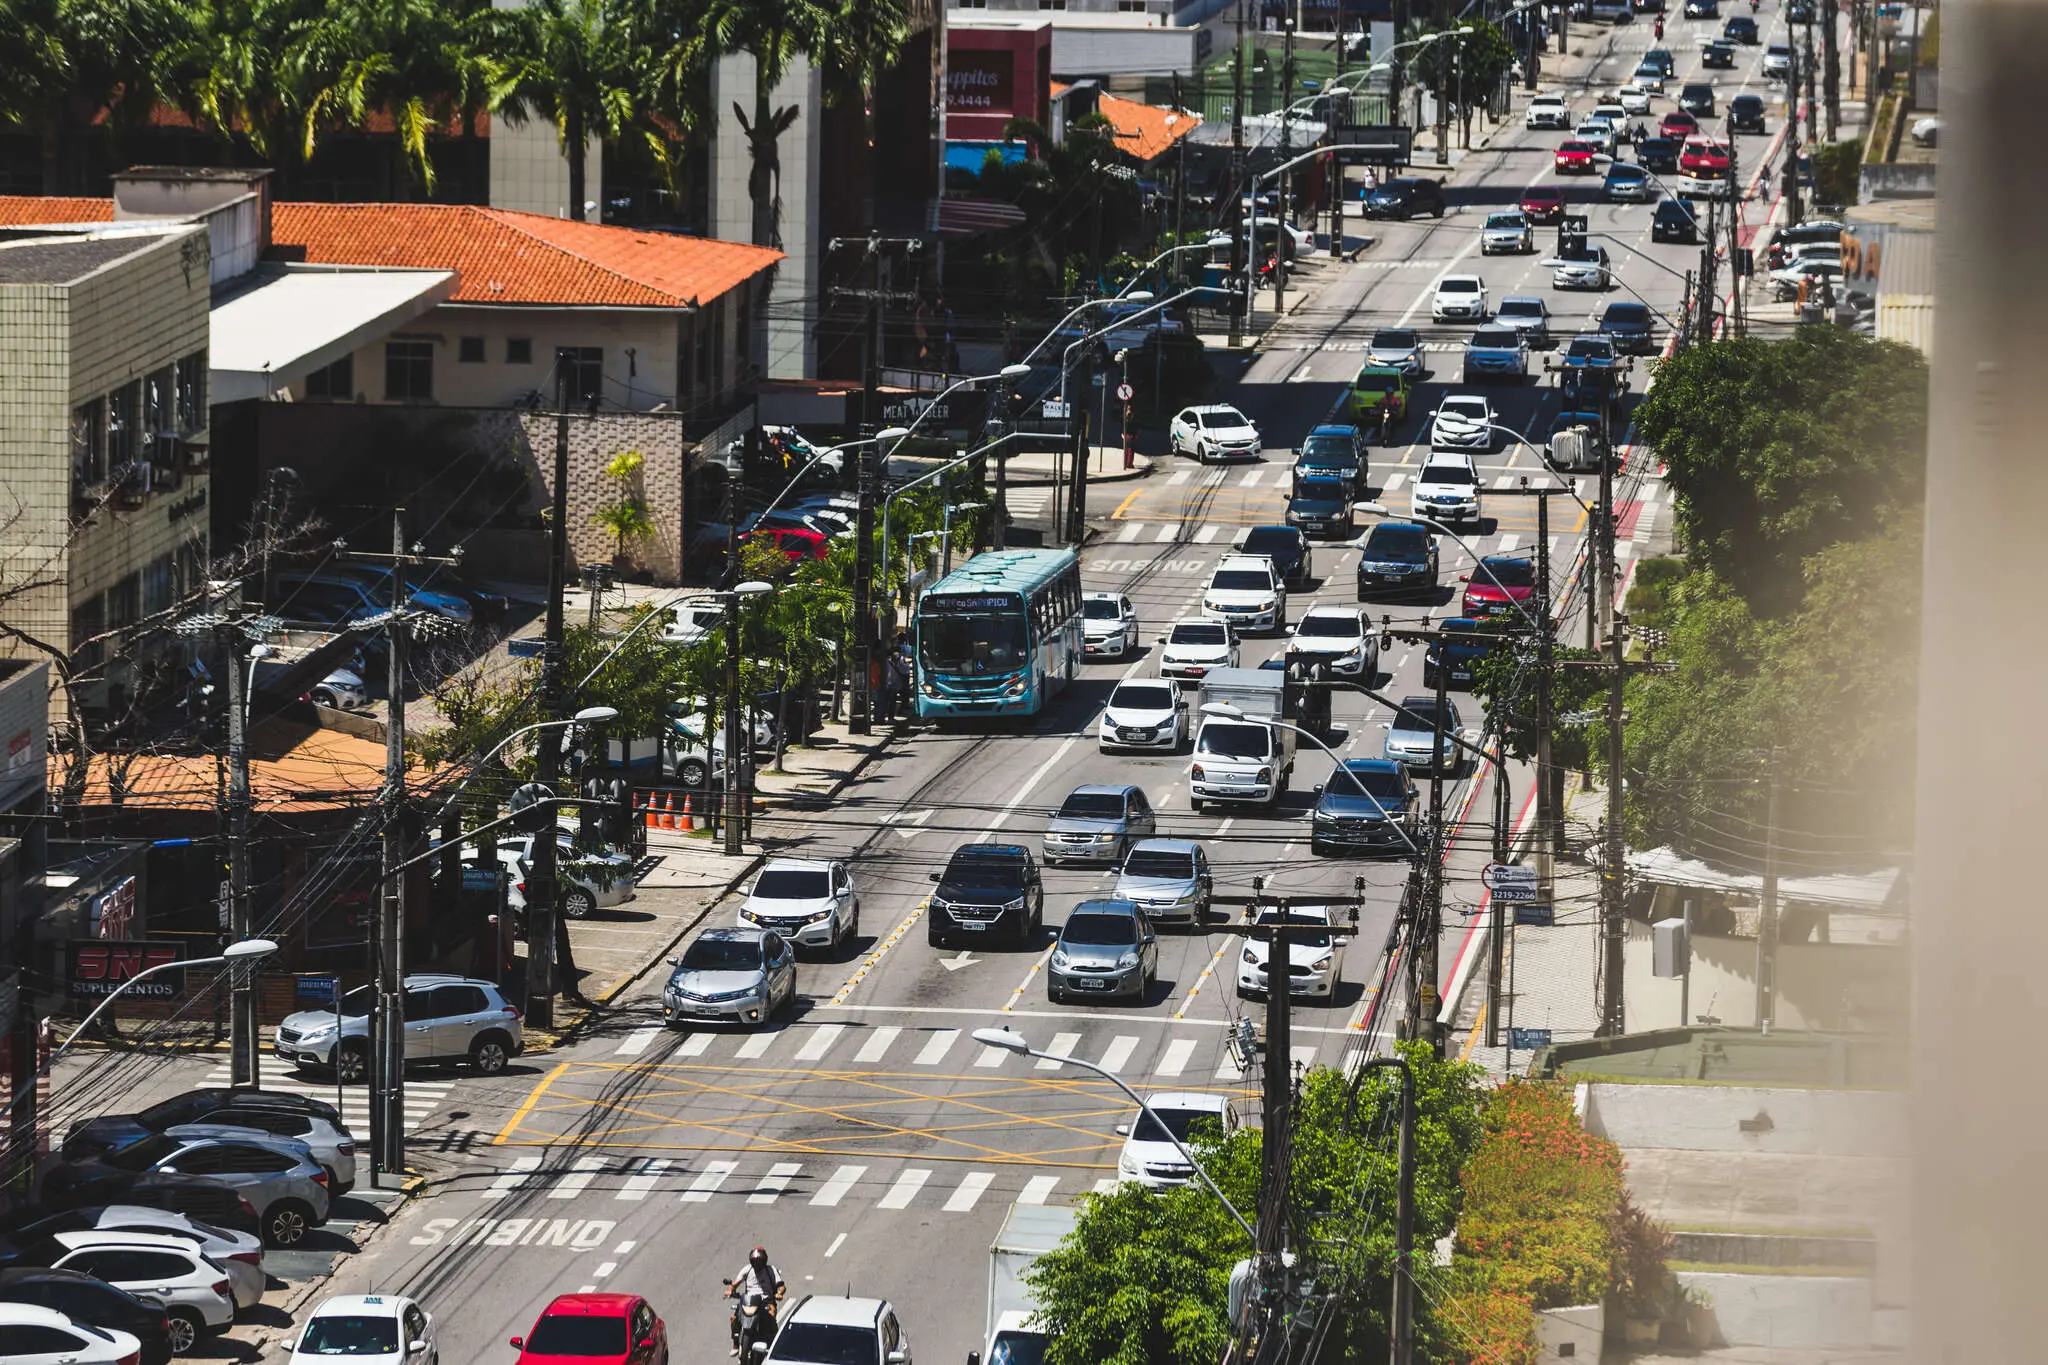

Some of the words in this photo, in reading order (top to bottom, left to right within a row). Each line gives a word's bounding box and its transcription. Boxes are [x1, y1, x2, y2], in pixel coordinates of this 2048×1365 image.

[883, 404, 908, 419] MEAT
[926, 404, 949, 419] BEER
[1492, 891, 1536, 900] 3219-2266
